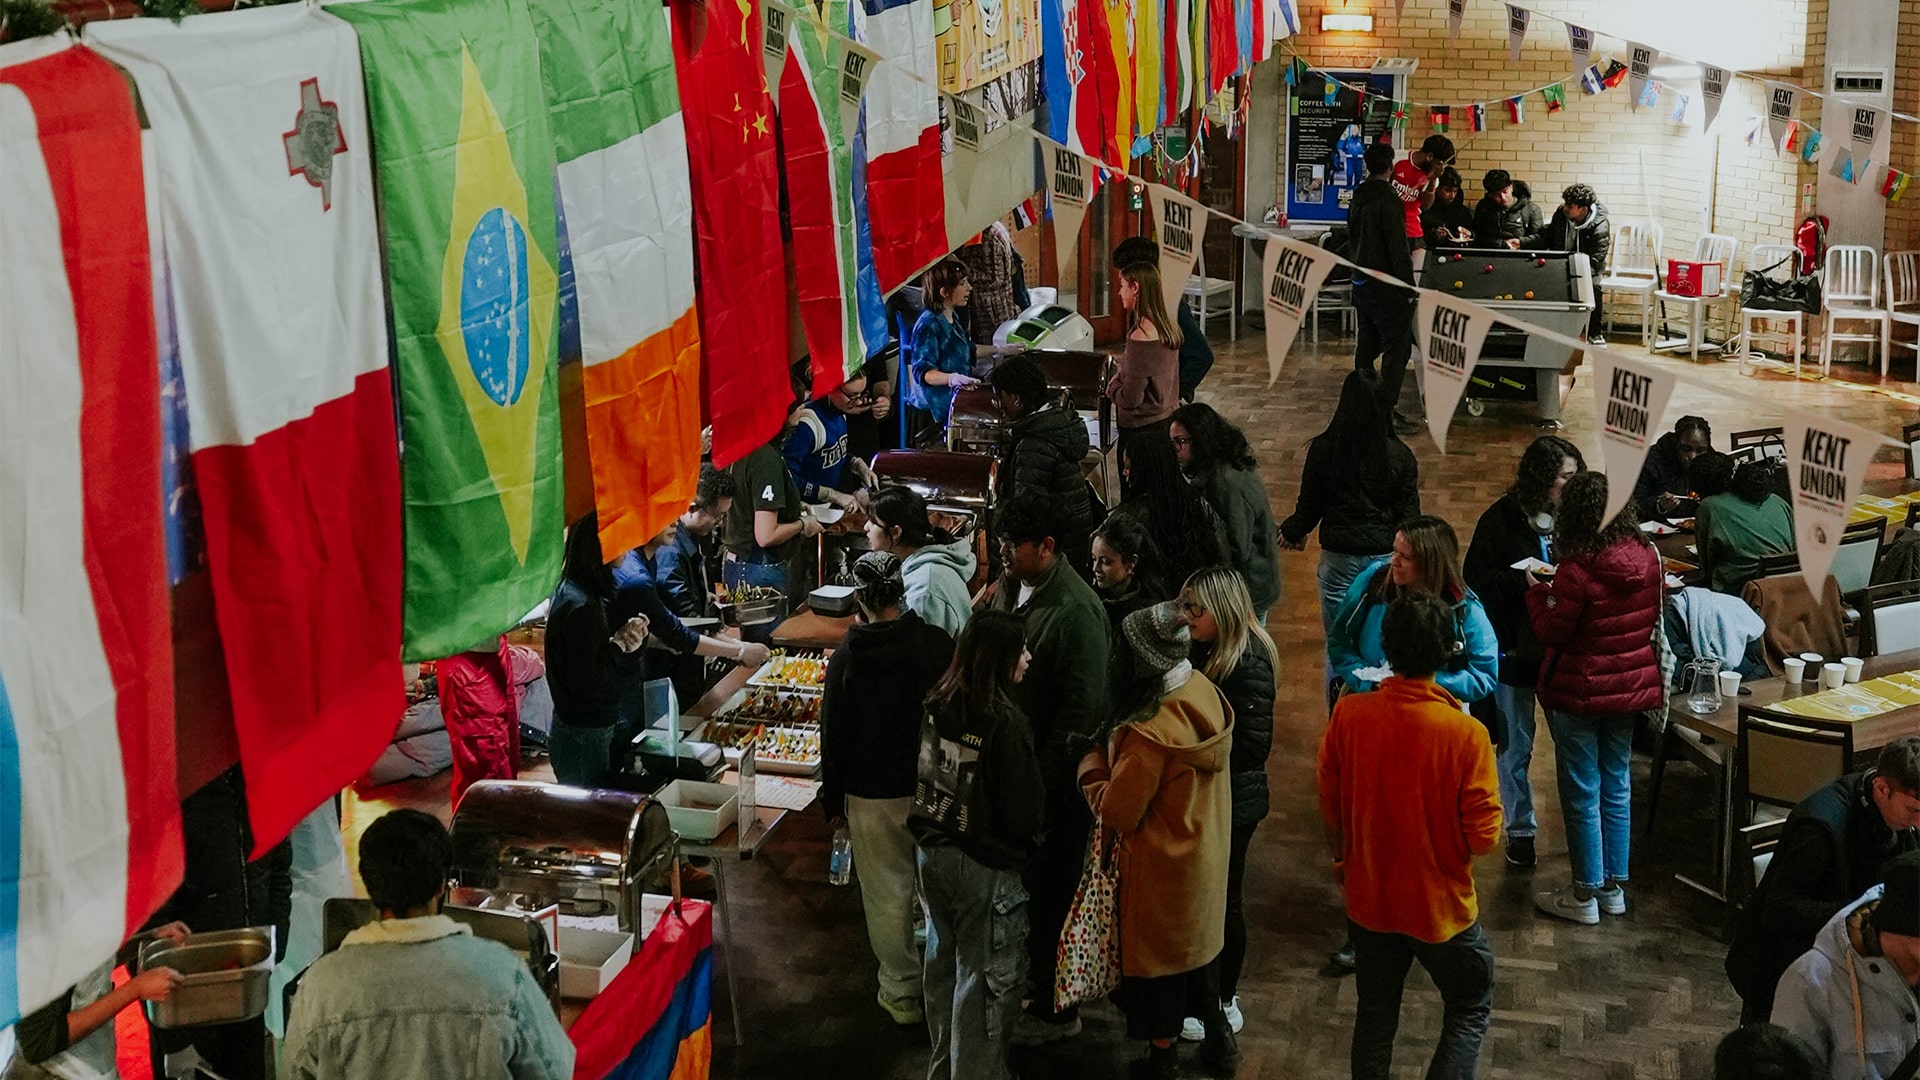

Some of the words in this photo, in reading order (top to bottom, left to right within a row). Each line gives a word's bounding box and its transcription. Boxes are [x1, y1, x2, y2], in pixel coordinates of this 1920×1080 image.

[768, 6, 784, 32] KENT
[1572, 25, 1588, 39] KENT
[766, 28, 784, 52] UNION
[844, 50, 866, 79] KENT
[1631, 61, 1649, 75] UNION
[1633, 47, 1650, 64] KENT
[842, 72, 861, 99] UNION
[1704, 80, 1721, 94] UNION
[1705, 67, 1722, 82] KENT
[1774, 88, 1793, 105] KENT
[951, 97, 975, 123] KENT
[1771, 102, 1791, 118] UNION
[1855, 108, 1875, 126] KENT
[955, 117, 978, 144] UNION
[1852, 122, 1873, 138] UNION
[1055, 148, 1081, 176] KENT
[1055, 173, 1083, 198] UNION
[1163, 198, 1192, 230] KENT
[1163, 224, 1192, 253] UNION
[1276, 247, 1315, 284] KENT
[1271, 274, 1306, 309] UNION
[1432, 305, 1470, 343] KENT
[1430, 336, 1466, 369] UNION
[1611, 367, 1652, 408] KENT
[1606, 400, 1649, 436] UNION
[1803, 427, 1850, 471] KENT
[762, 484, 775, 501] 4
[1801, 464, 1846, 502] UNION
